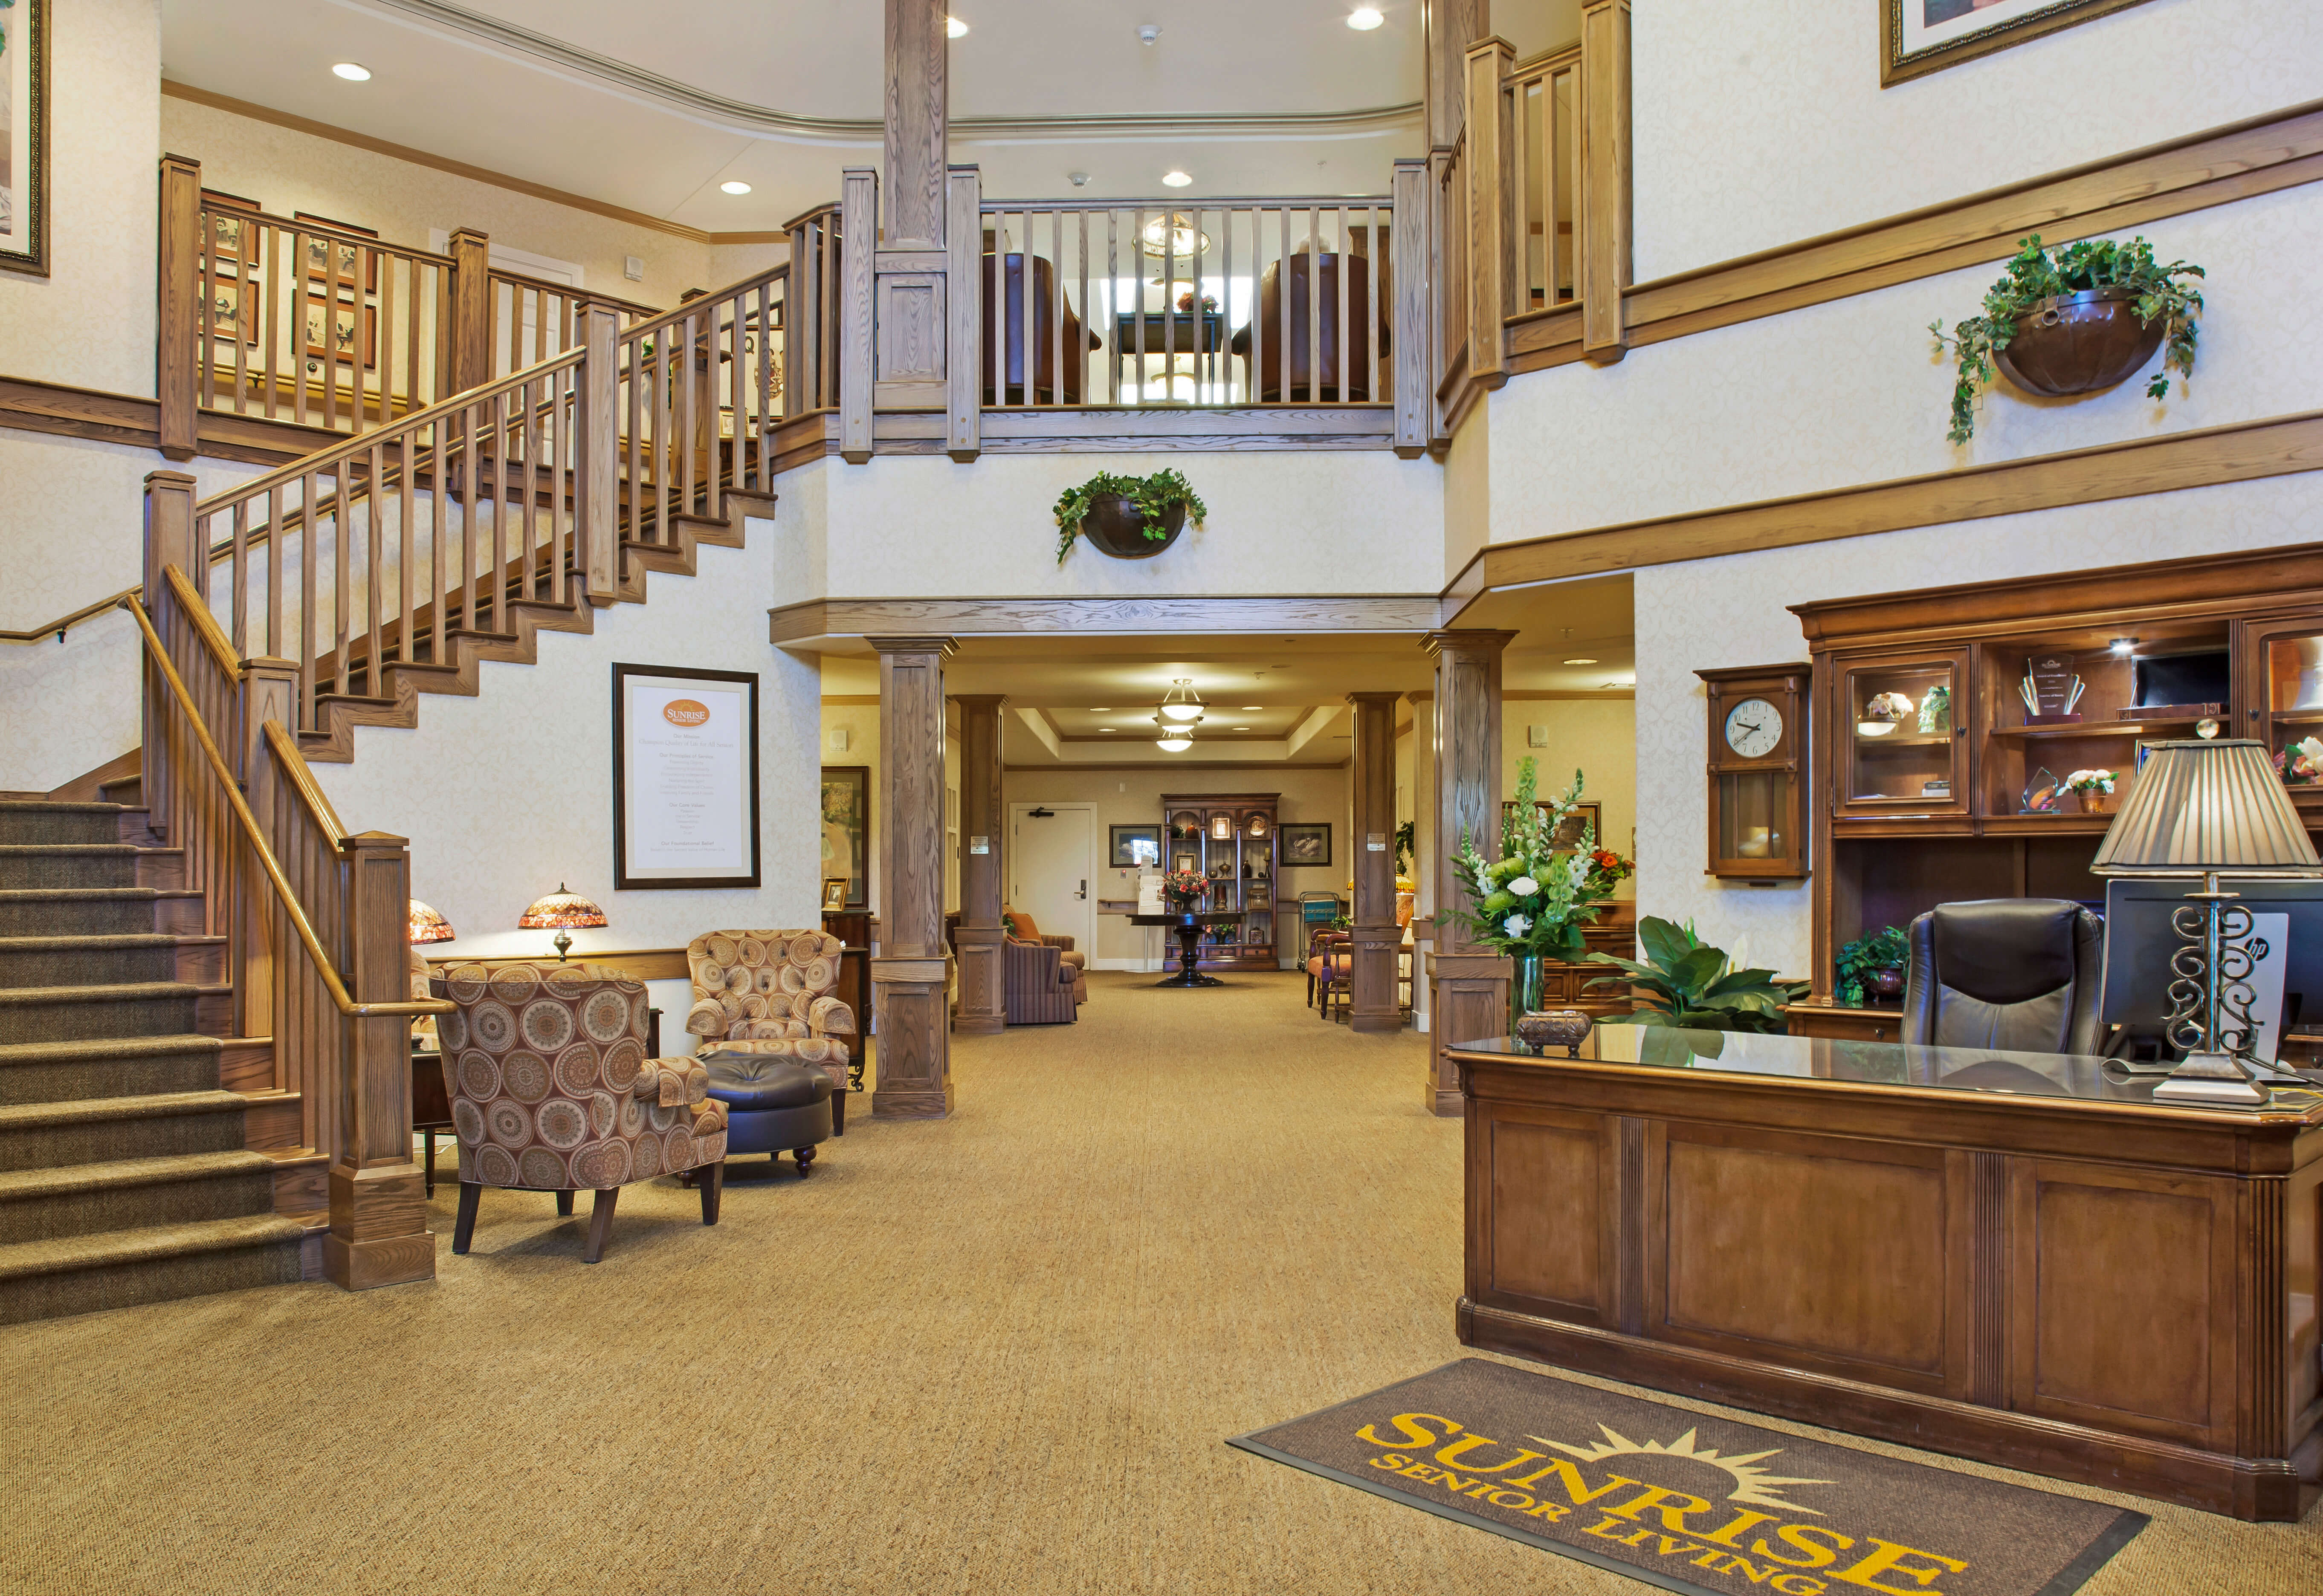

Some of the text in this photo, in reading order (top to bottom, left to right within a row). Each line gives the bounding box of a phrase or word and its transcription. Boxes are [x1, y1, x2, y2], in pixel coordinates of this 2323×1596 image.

[1743, 705, 1747, 714] 11
[1752, 703, 1759, 711] 12
[1765, 704, 1767, 713] 1
[667, 709, 705, 720] SUNRISE
[1734, 713, 1740, 722] 10
[1773, 711, 1777, 720] 2
[1776, 723, 1781, 732] 3
[1771, 734, 1777, 743] 4
[1743, 743, 1747, 752] 7
[1752, 746, 1757, 754] 6
[1764, 743, 1769, 751] 5
[2248, 938, 2266, 962] hp
[1355, 1413, 1968, 1596] SUNRISE
[1369, 1454, 1828, 1596] SENIOR LIVING
